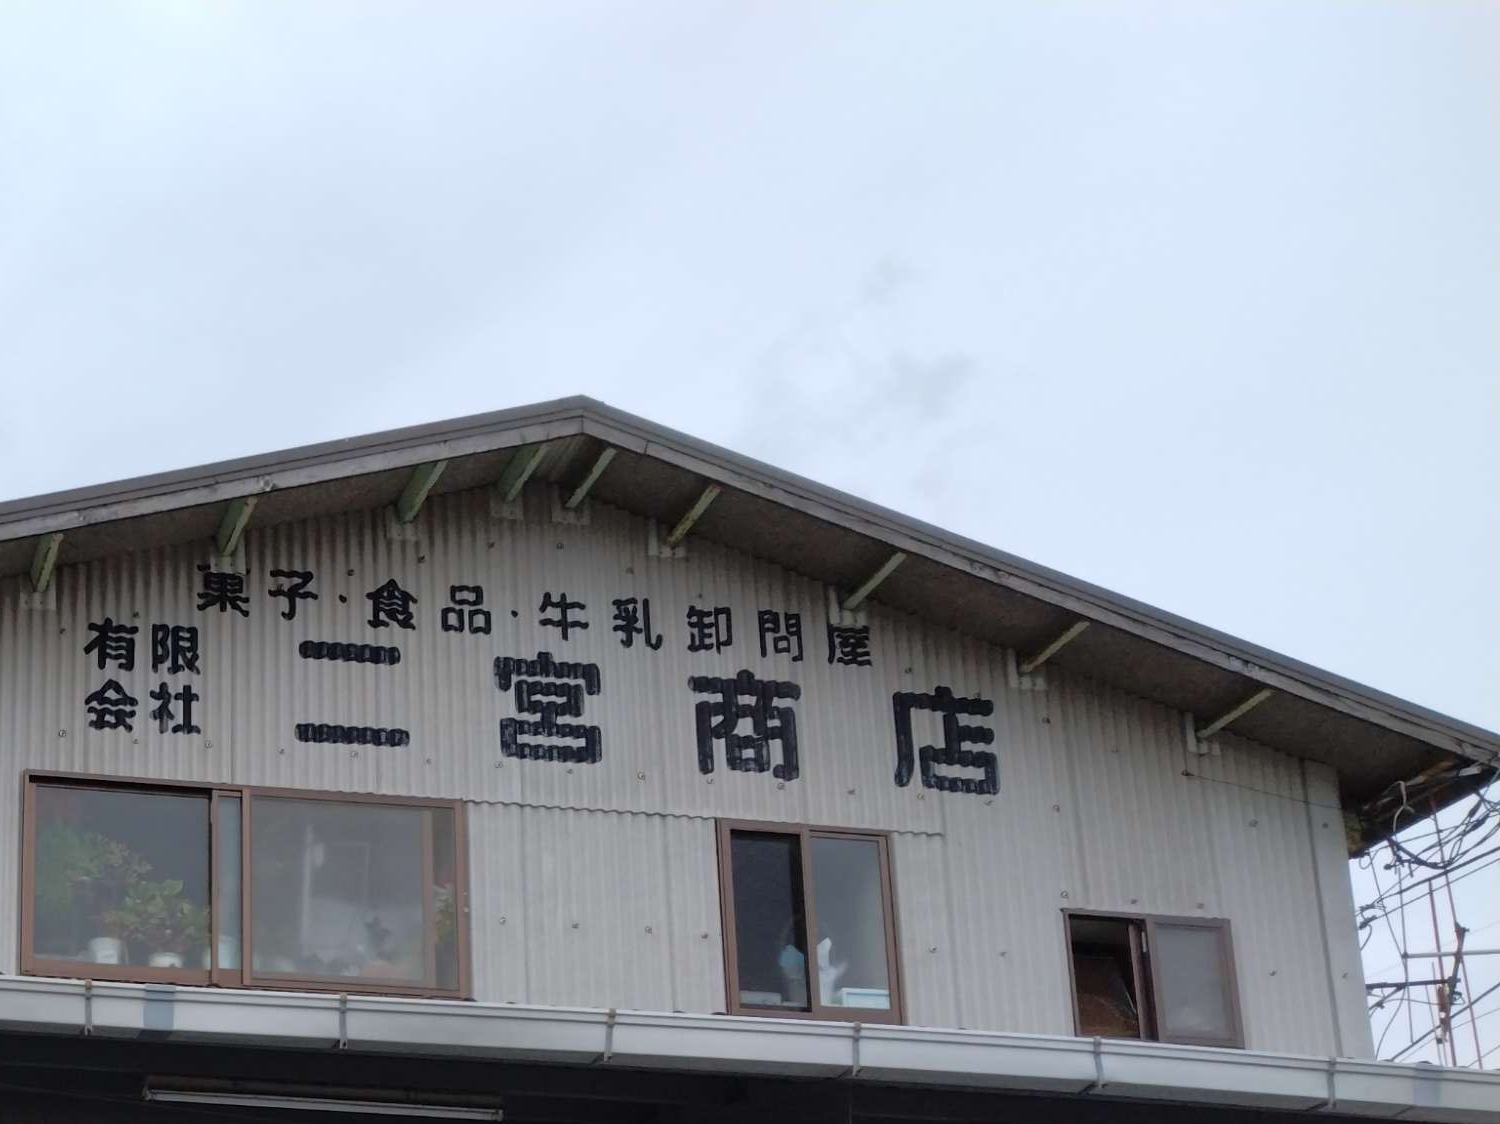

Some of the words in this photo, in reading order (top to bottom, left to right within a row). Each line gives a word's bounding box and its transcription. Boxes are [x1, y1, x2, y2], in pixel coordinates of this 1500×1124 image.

[84, 617, 201, 675] 有限
[84, 679, 202, 735] 会社
[294, 640, 1000, 795] 二宮商店
